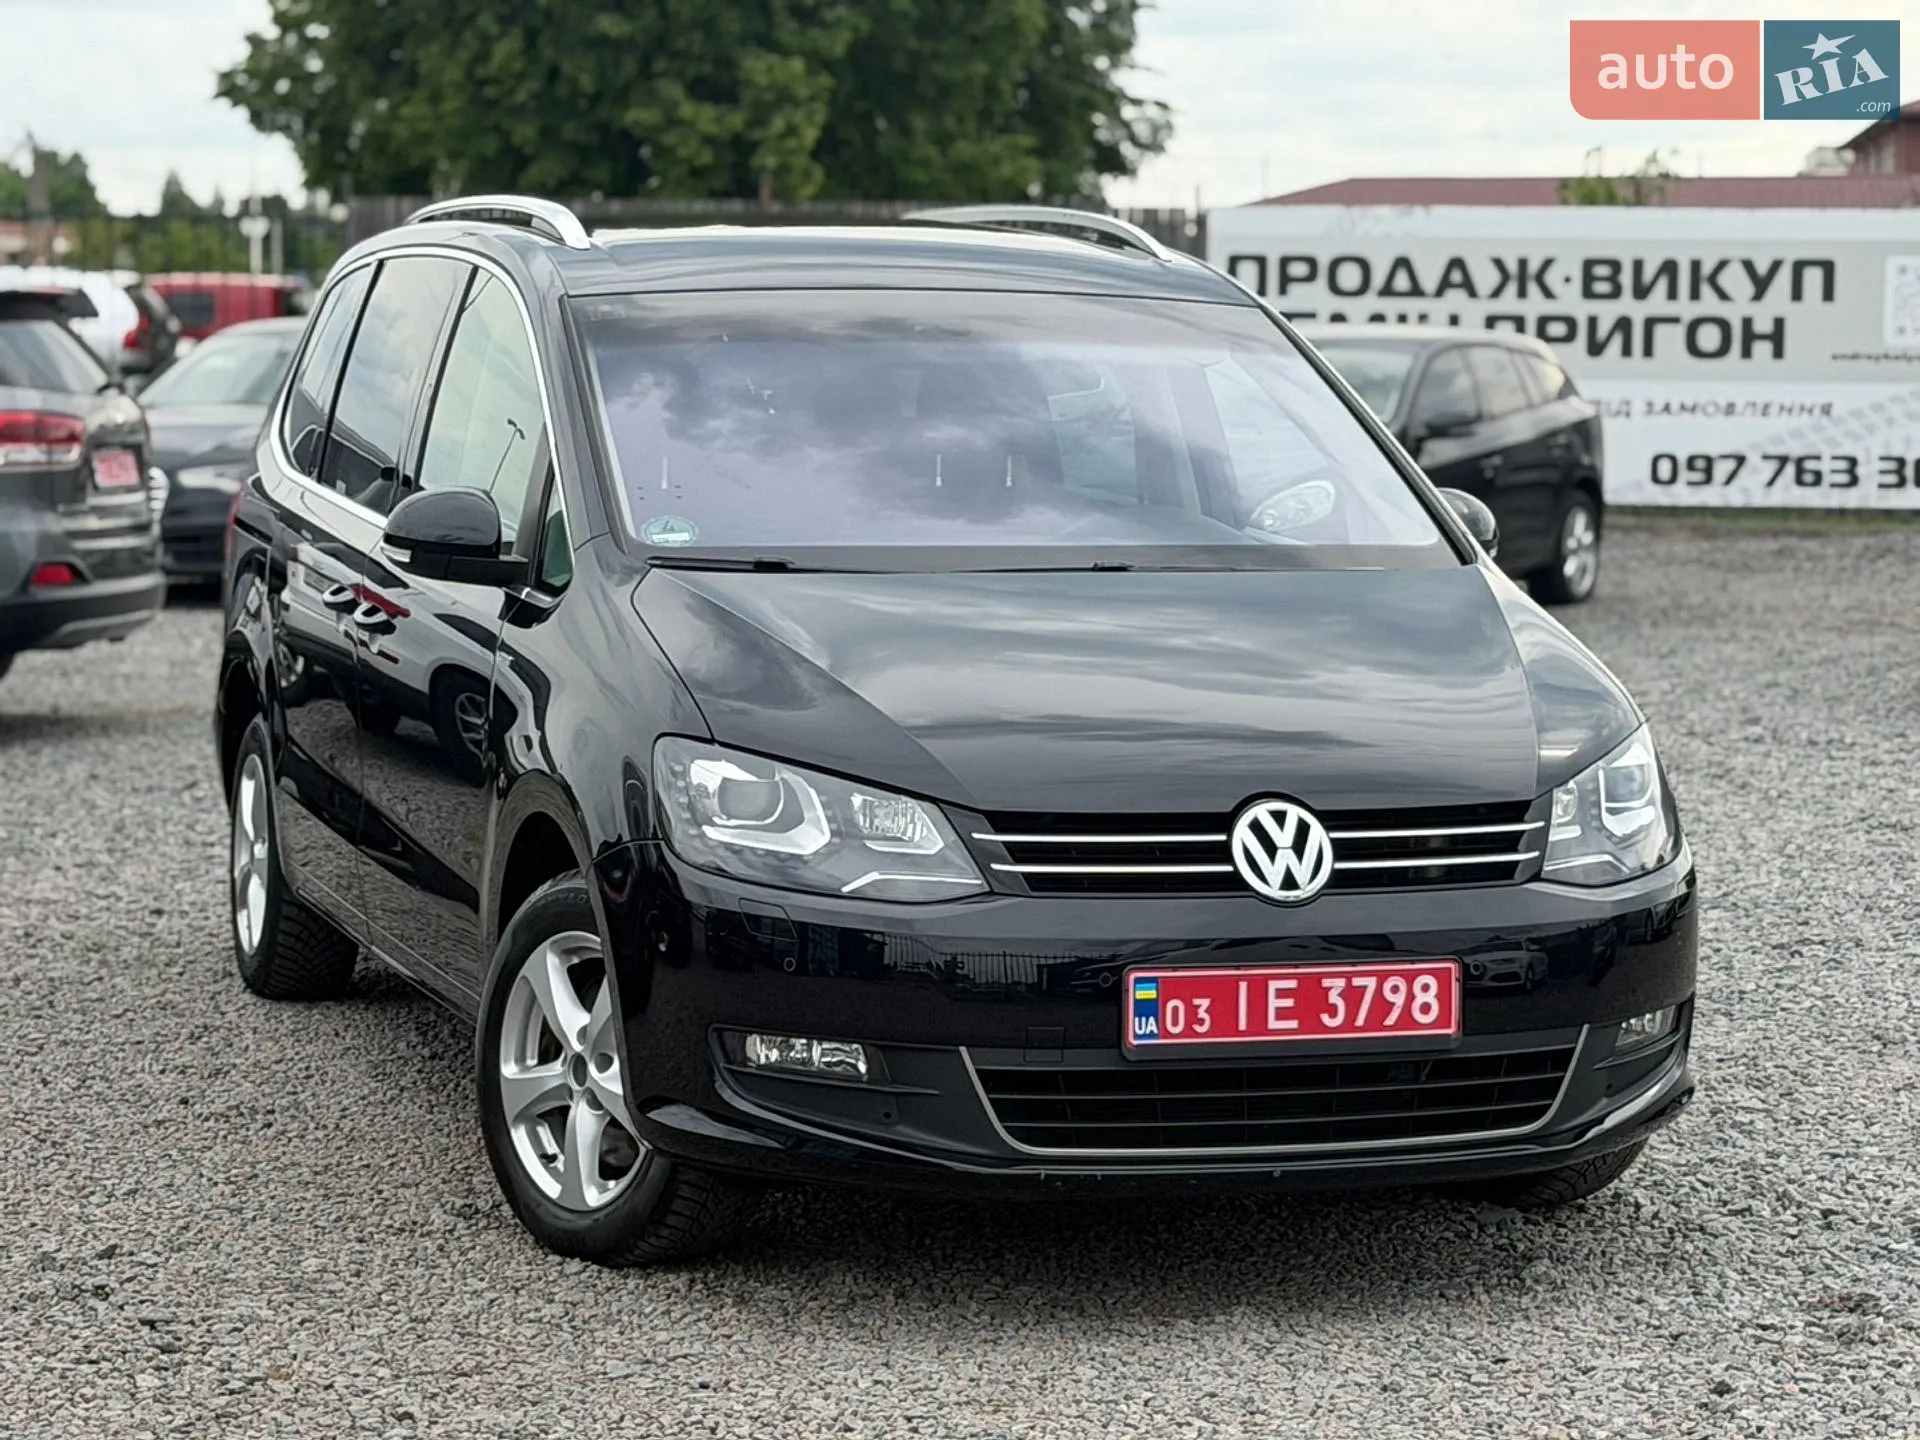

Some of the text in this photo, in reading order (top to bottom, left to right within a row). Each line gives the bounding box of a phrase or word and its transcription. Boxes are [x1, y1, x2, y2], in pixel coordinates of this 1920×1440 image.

[1650, 454, 1920, 489] 097 763 3
[1165, 998, 1212, 1034] 03
[1319, 974, 1440, 1028] 3798
[1134, 1016, 1158, 1035] UA
